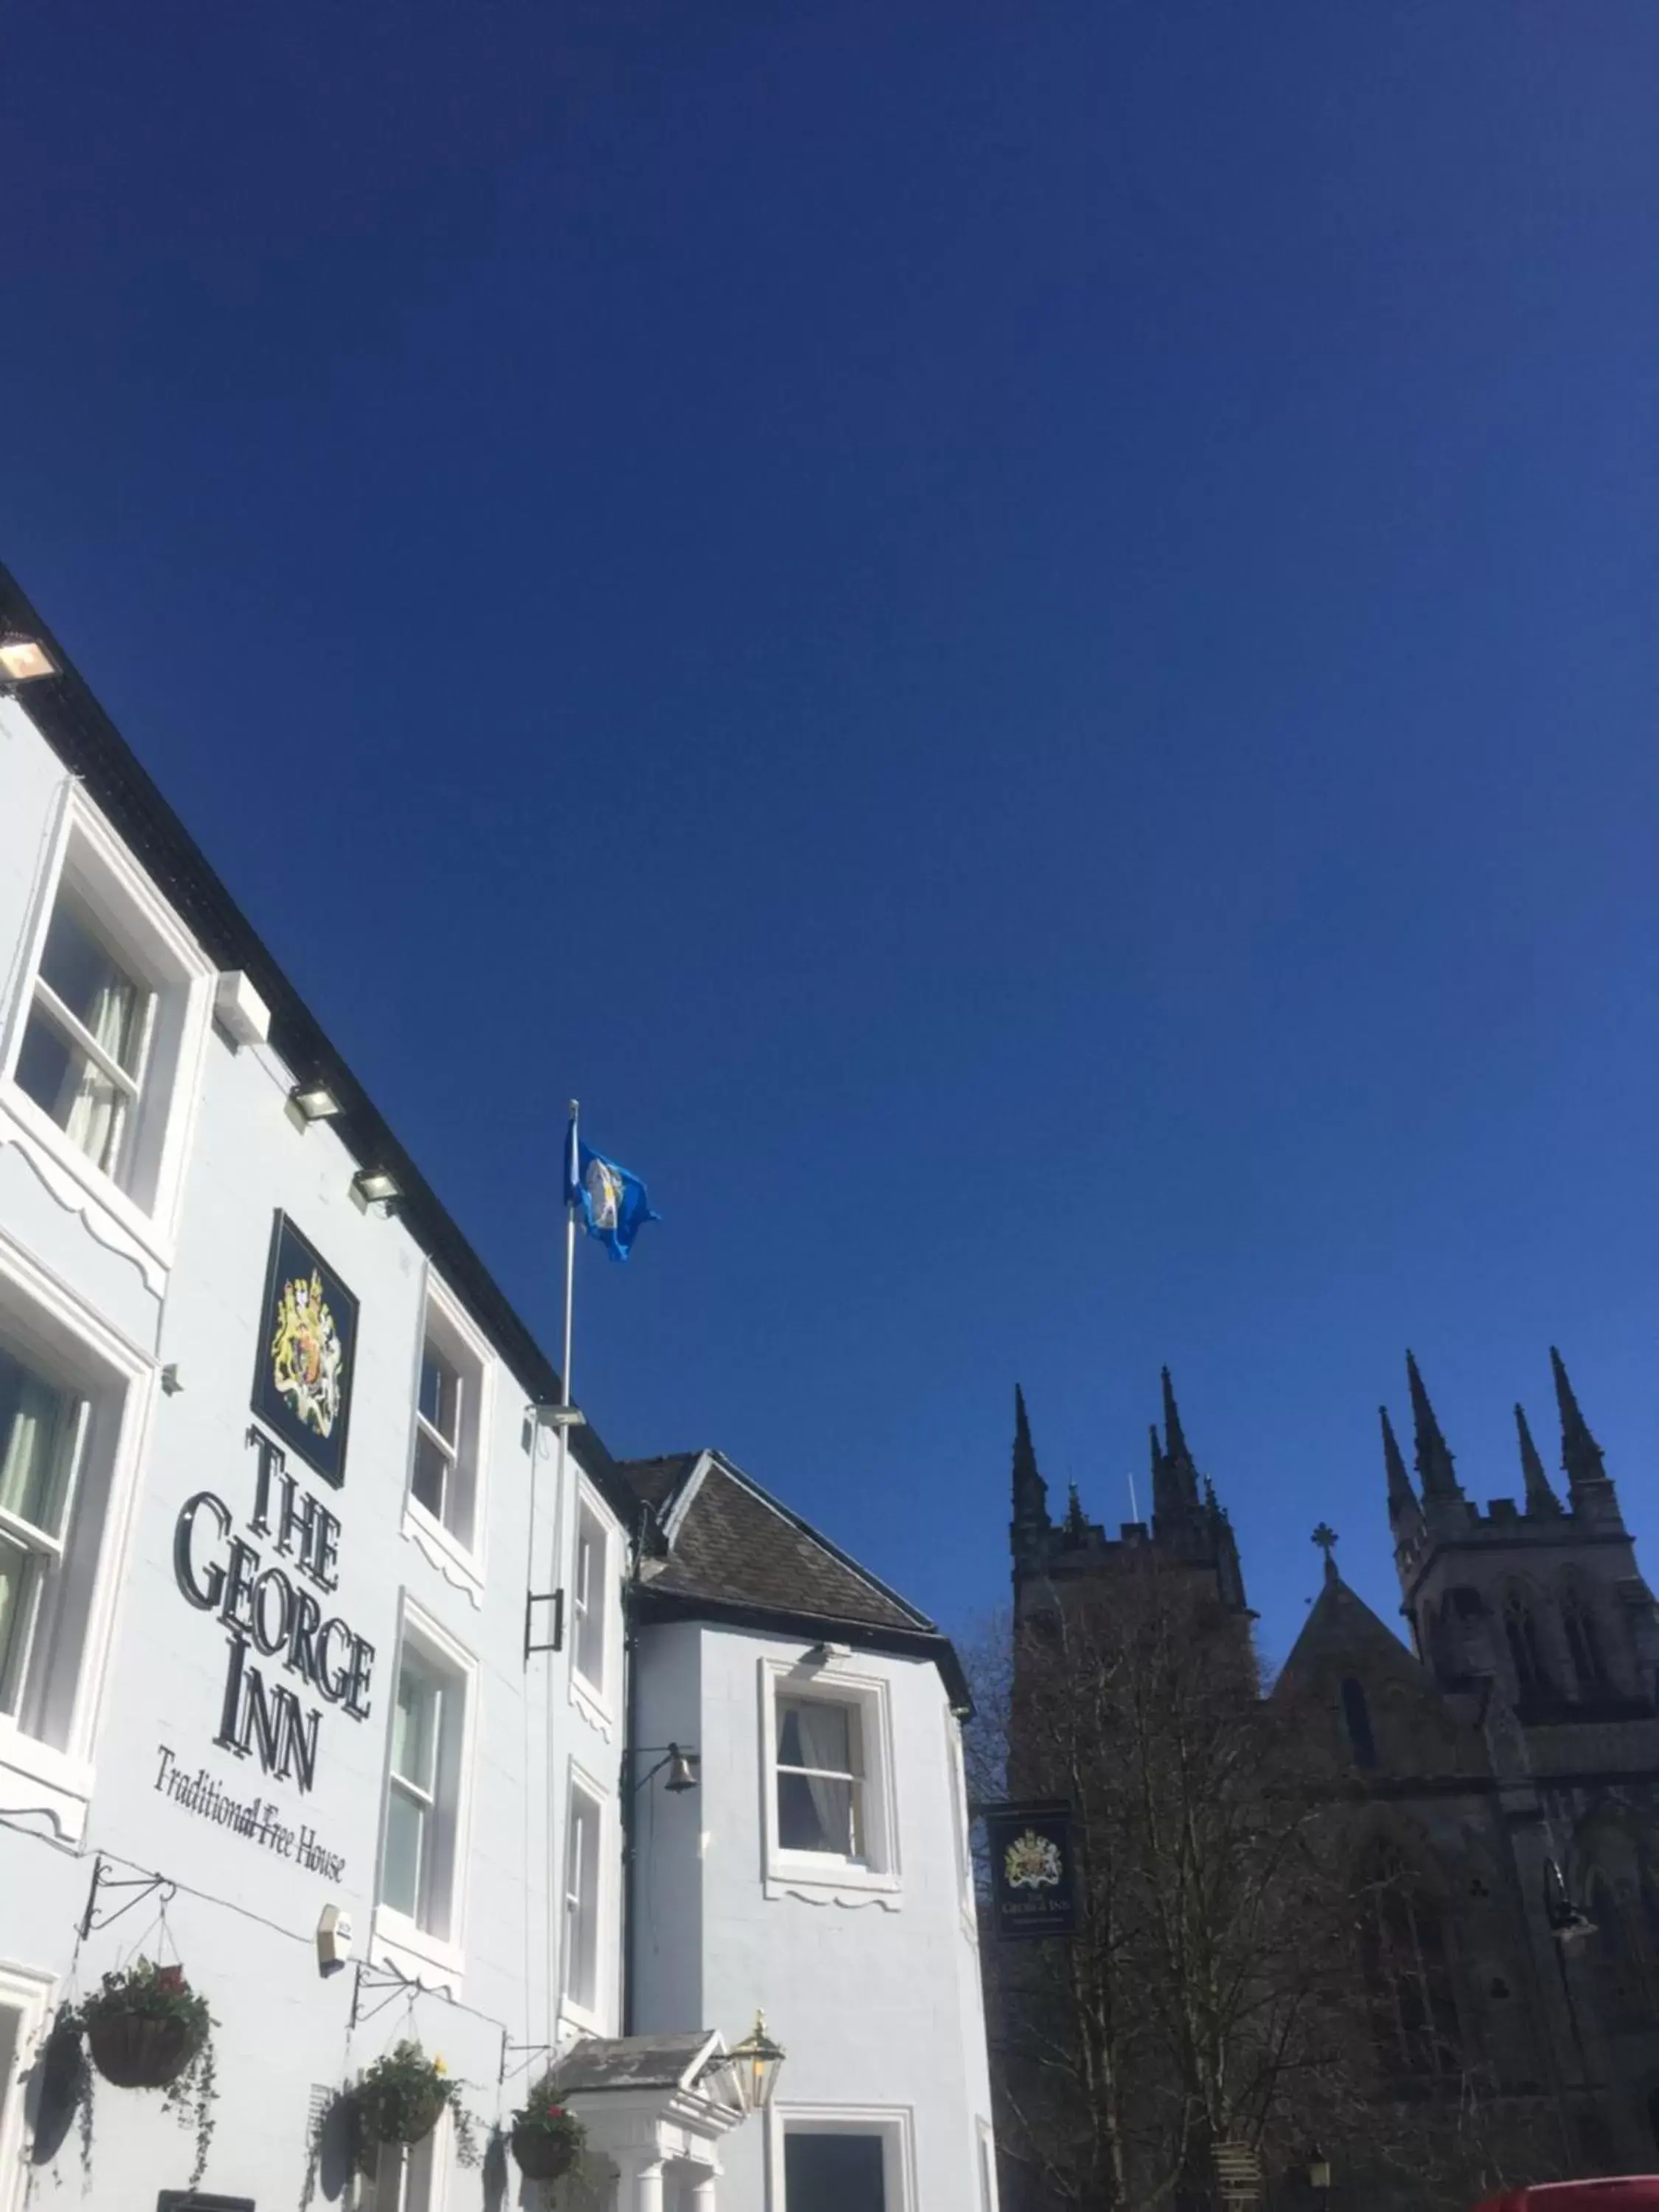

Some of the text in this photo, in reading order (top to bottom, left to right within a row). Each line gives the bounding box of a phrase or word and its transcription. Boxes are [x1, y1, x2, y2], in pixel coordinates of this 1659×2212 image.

[245, 1424, 341, 1595] THE
[173, 1491, 375, 1722] GEORGE
[212, 1632, 324, 1796] INN
[153, 1744, 346, 1883] Traditional Free House
